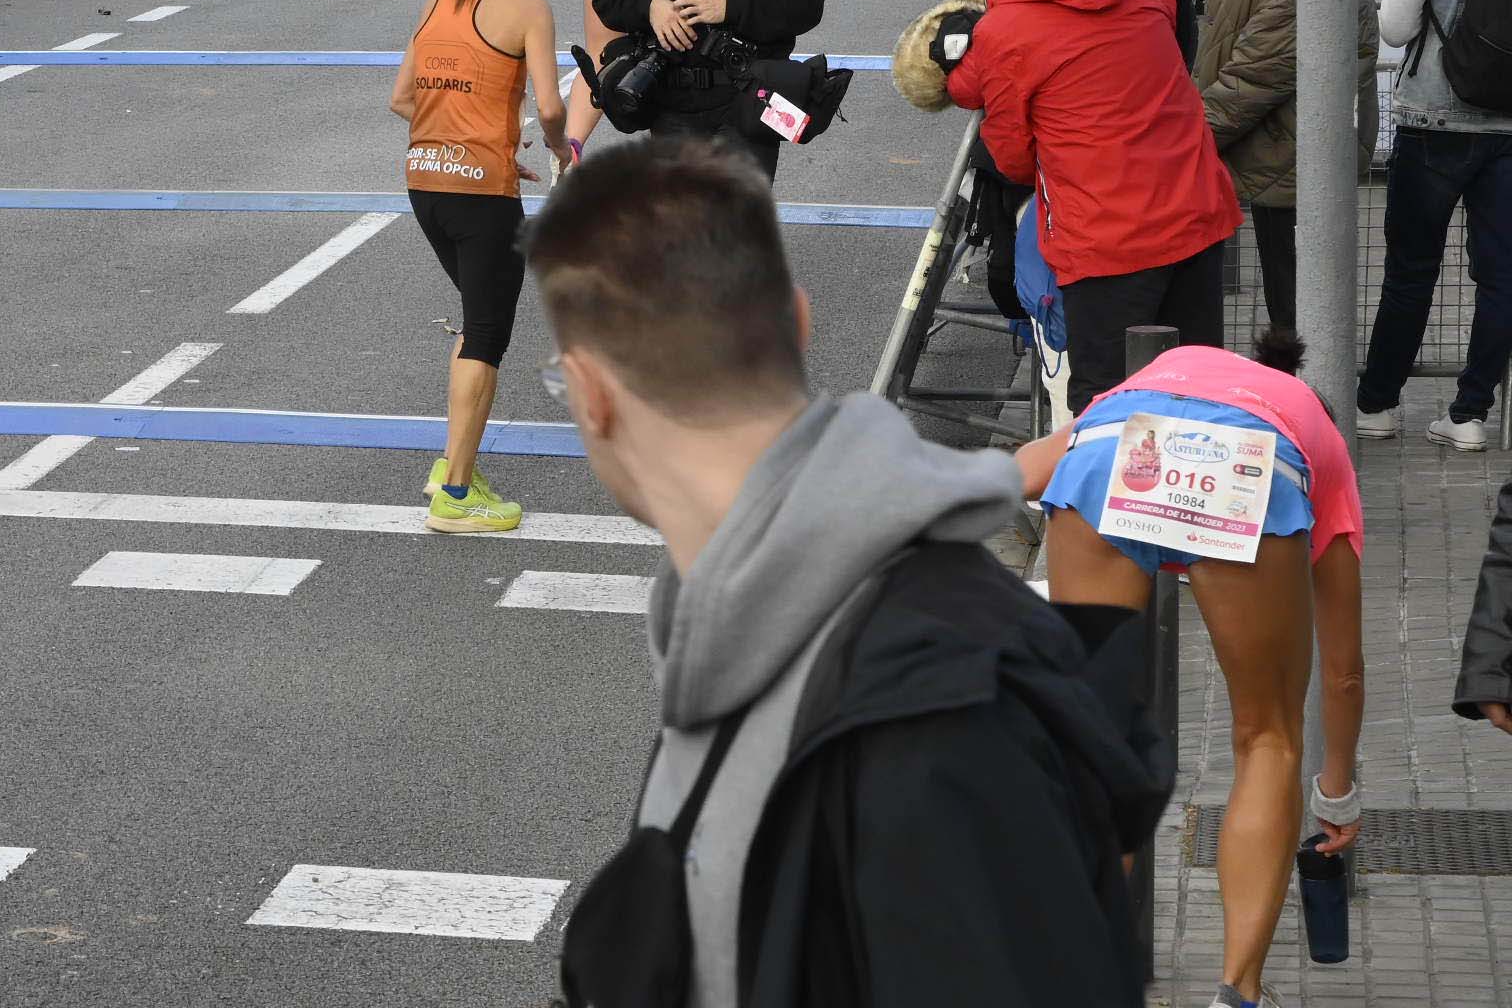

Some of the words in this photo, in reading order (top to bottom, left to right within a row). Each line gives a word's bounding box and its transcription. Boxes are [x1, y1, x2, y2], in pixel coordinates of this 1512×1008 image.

[425, 56, 460, 72] CORRE
[416, 76, 473, 94] SOLIDARIS
[438, 144, 466, 162] NO
[419, 160, 441, 173] UNA
[443, 162, 484, 180] OPCIÓ
[1235, 446, 1264, 458] SUMA
[1164, 469, 1217, 493] 016
[1167, 492, 1206, 509] 10984
[1124, 501, 1165, 516] CARRERA
[1166, 509, 1179, 519] DE
[1180, 511, 1192, 522] LA
[1194, 514, 1225, 529] MUJER
[1116, 517, 1163, 534] OYSHO
[1198, 534, 1246, 552] Santander
